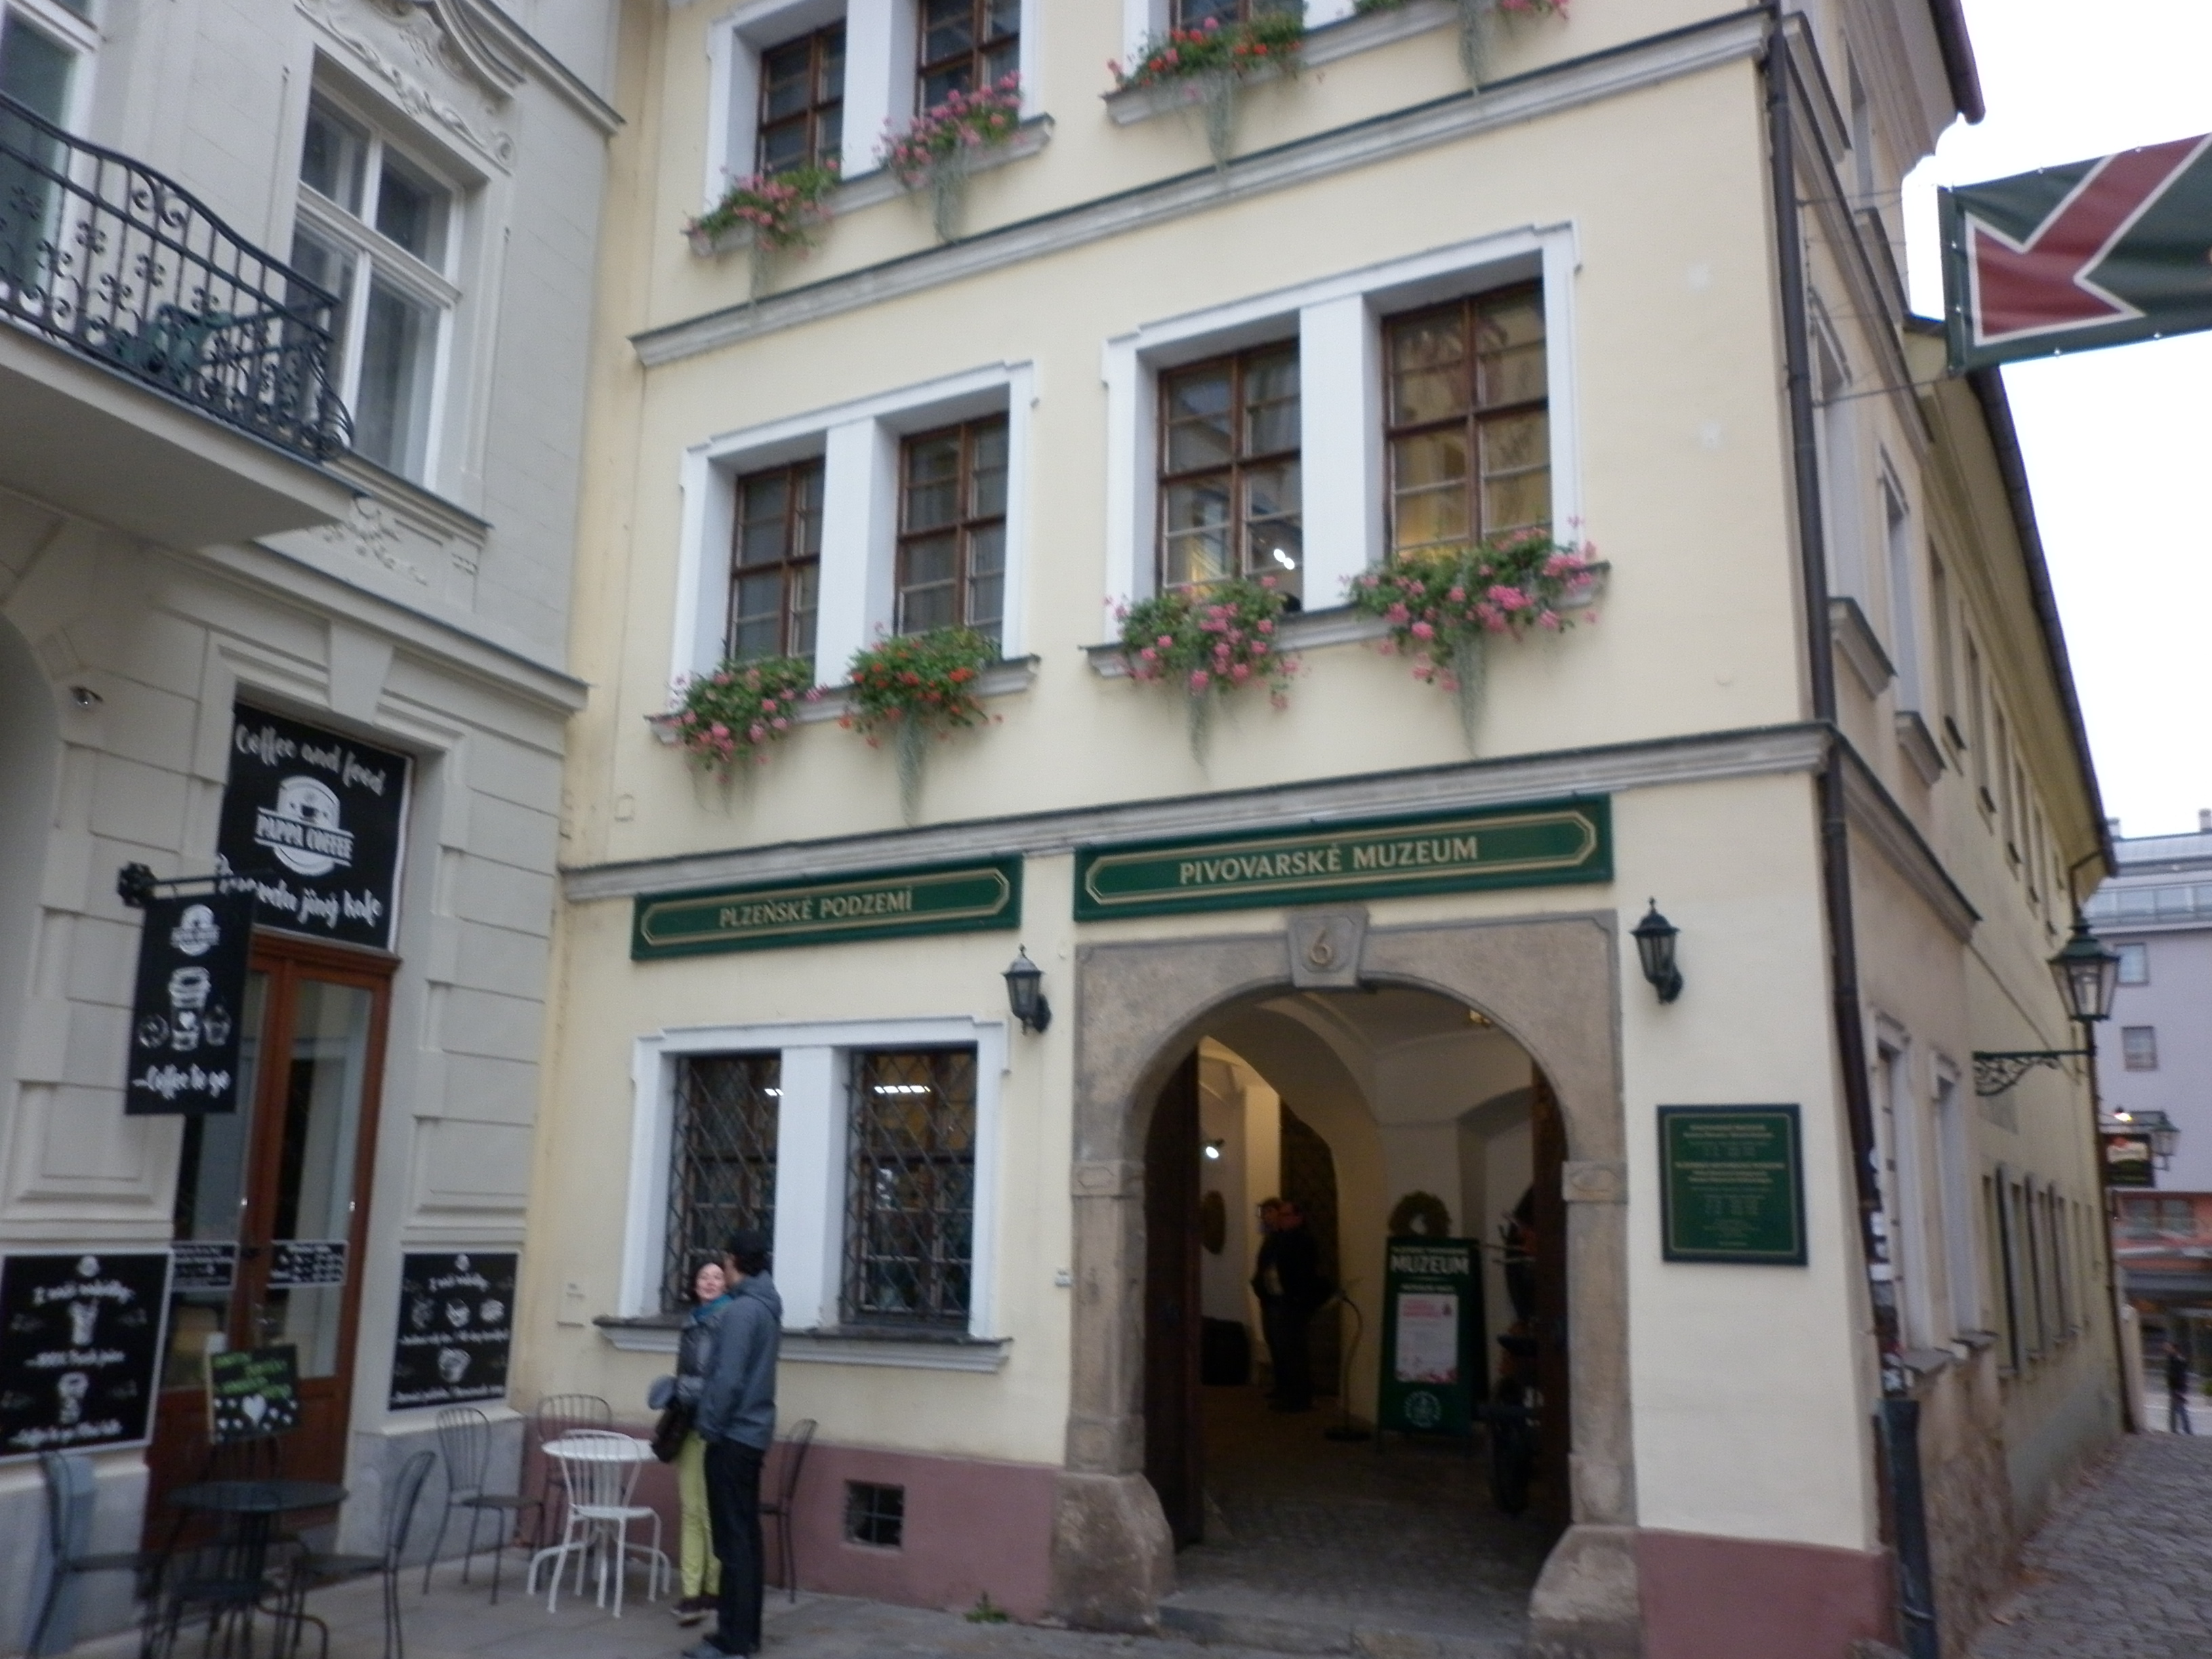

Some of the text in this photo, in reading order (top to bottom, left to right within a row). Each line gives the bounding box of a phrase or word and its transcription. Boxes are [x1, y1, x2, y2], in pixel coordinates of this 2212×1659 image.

[235, 723, 386, 796] Coffee and food
[306, 826, 354, 861] COFFEE
[1178, 836, 1478, 885] PIVOVARSKÉ MUZEUM
[720, 884, 914, 928] PLZEŇSKÉ PODZEMÍ
[1309, 926, 1333, 967] 6
[1390, 1254, 1469, 1275] MUZEUM
